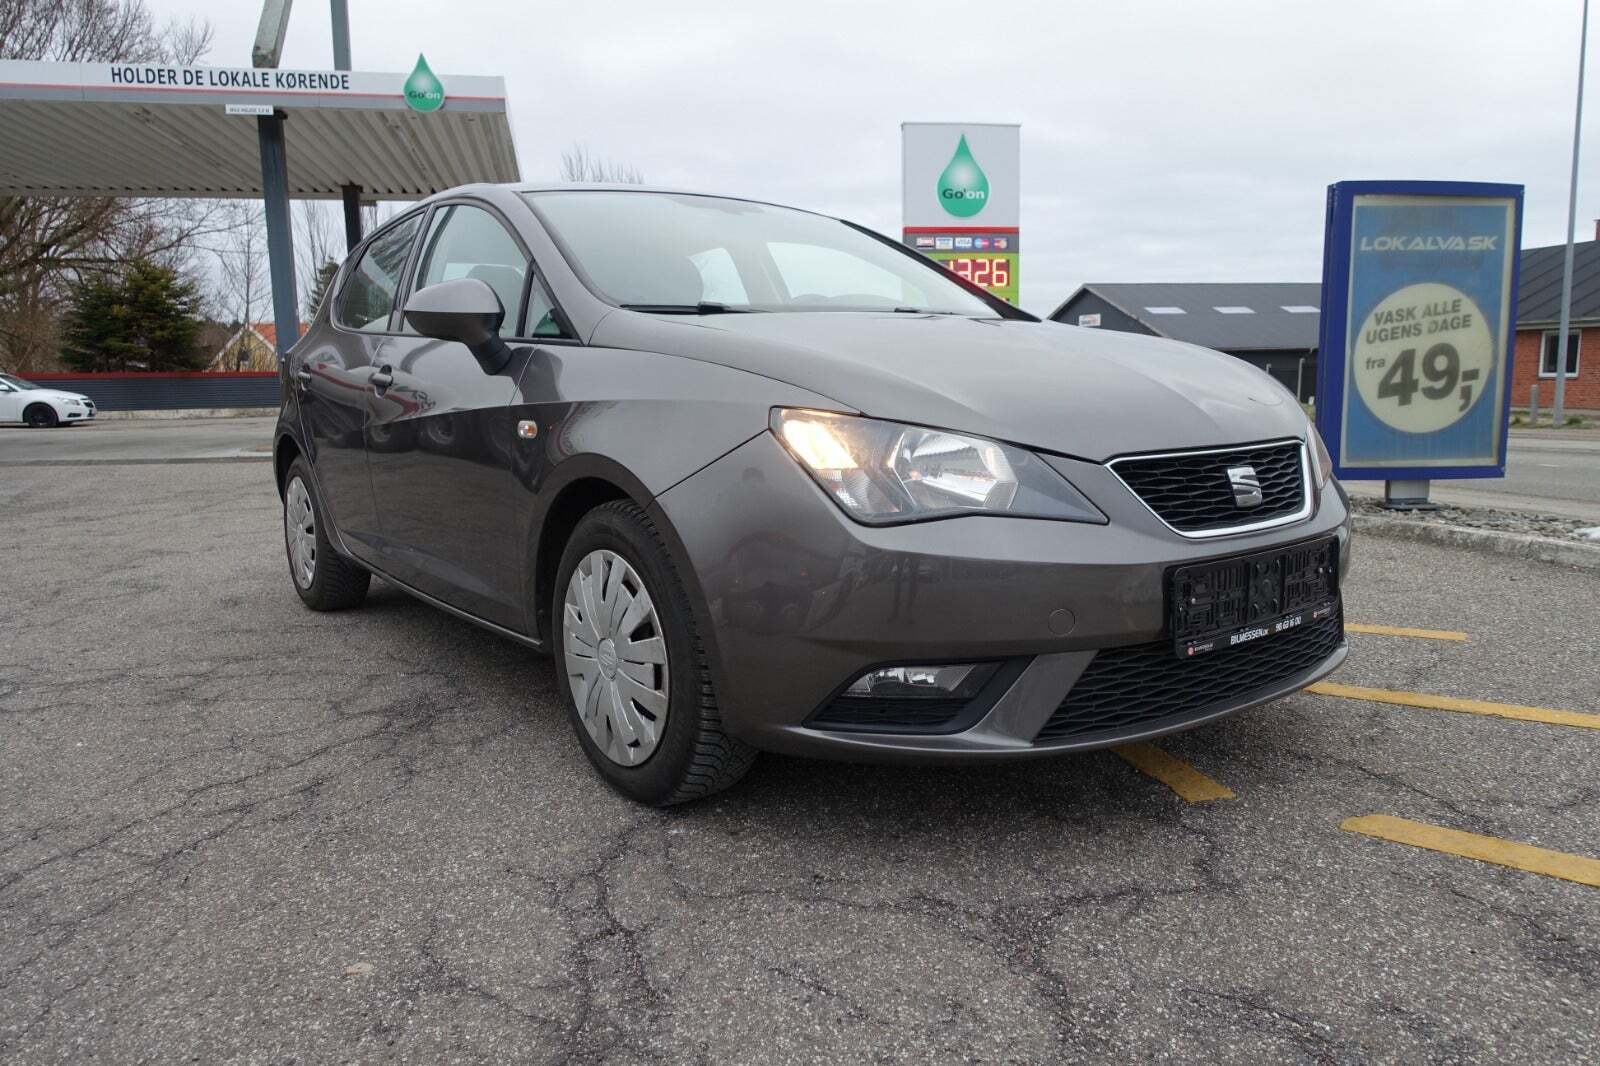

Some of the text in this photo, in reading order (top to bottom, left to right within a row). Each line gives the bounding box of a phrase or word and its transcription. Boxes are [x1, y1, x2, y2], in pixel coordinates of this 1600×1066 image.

[111, 67, 350, 90] HOLDER DE LOKALE KØRENDE
[942, 188, 985, 200] Go'on
[1360, 236, 1498, 251] LOKALVASK
[1374, 299, 1463, 326] VASK ALLE
[1365, 314, 1473, 344] UGENS DAGE
[1365, 356, 1386, 370] fra
